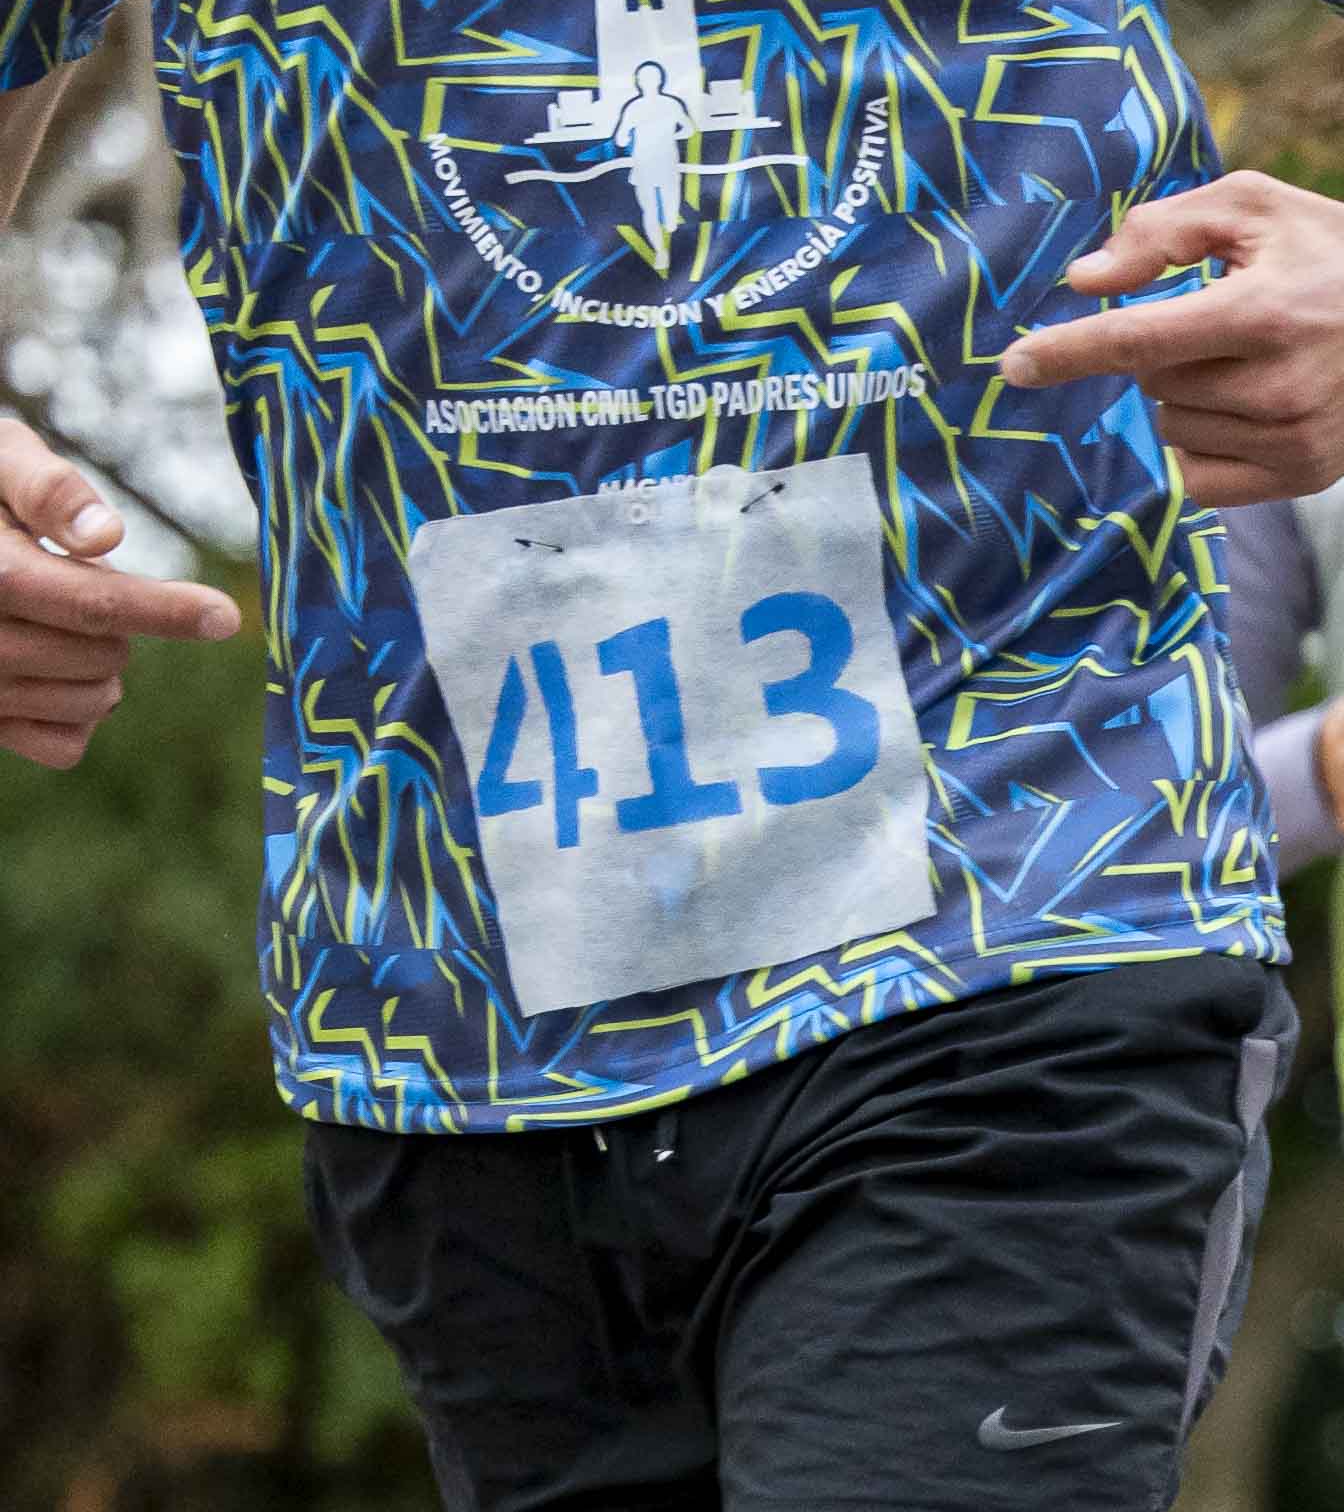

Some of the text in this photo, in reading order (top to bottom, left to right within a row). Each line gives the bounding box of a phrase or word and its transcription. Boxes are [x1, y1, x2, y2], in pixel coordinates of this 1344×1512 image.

[426, 96, 890, 329] MOVIMIENTO, INCLUSIÓN Y ENERGÍA POSITIVA
[425, 362, 927, 435] ASOCIACIÓN CIVIL TGD PADRES UNIDOS
[477, 590, 881, 849] 413
